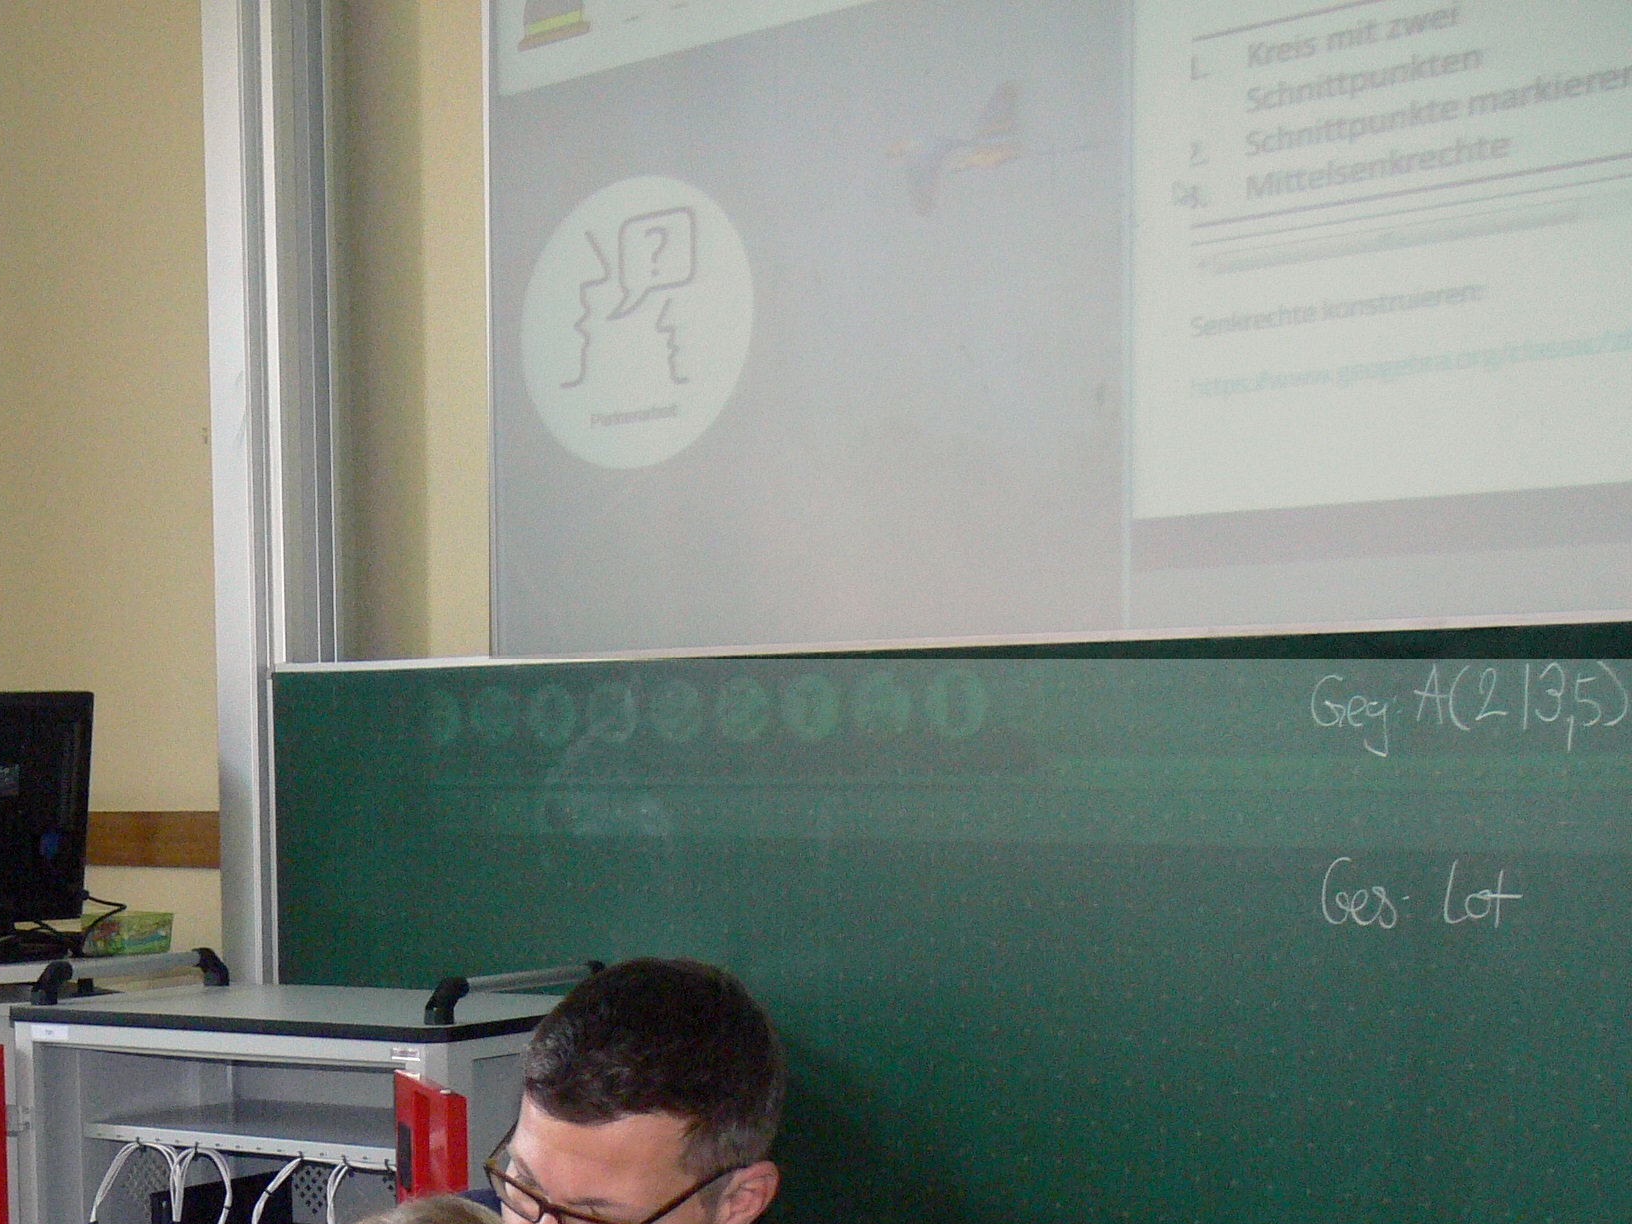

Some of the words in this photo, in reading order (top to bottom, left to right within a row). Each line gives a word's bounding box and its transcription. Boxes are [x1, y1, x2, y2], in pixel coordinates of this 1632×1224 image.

[1247, 33, 1317, 67] Kreis
[1326, 22, 1378, 53] mit
[1385, 4, 1463, 41] zwei
[1244, 46, 1485, 114] Schnittpunkten
[1243, 98, 1460, 157] Schnittpunkte
[1244, 134, 1512, 201] Mittelsenkrechte
[1189, 304, 1317, 339] Senkrechte
[1443, 859, 1524, 930] Lot
